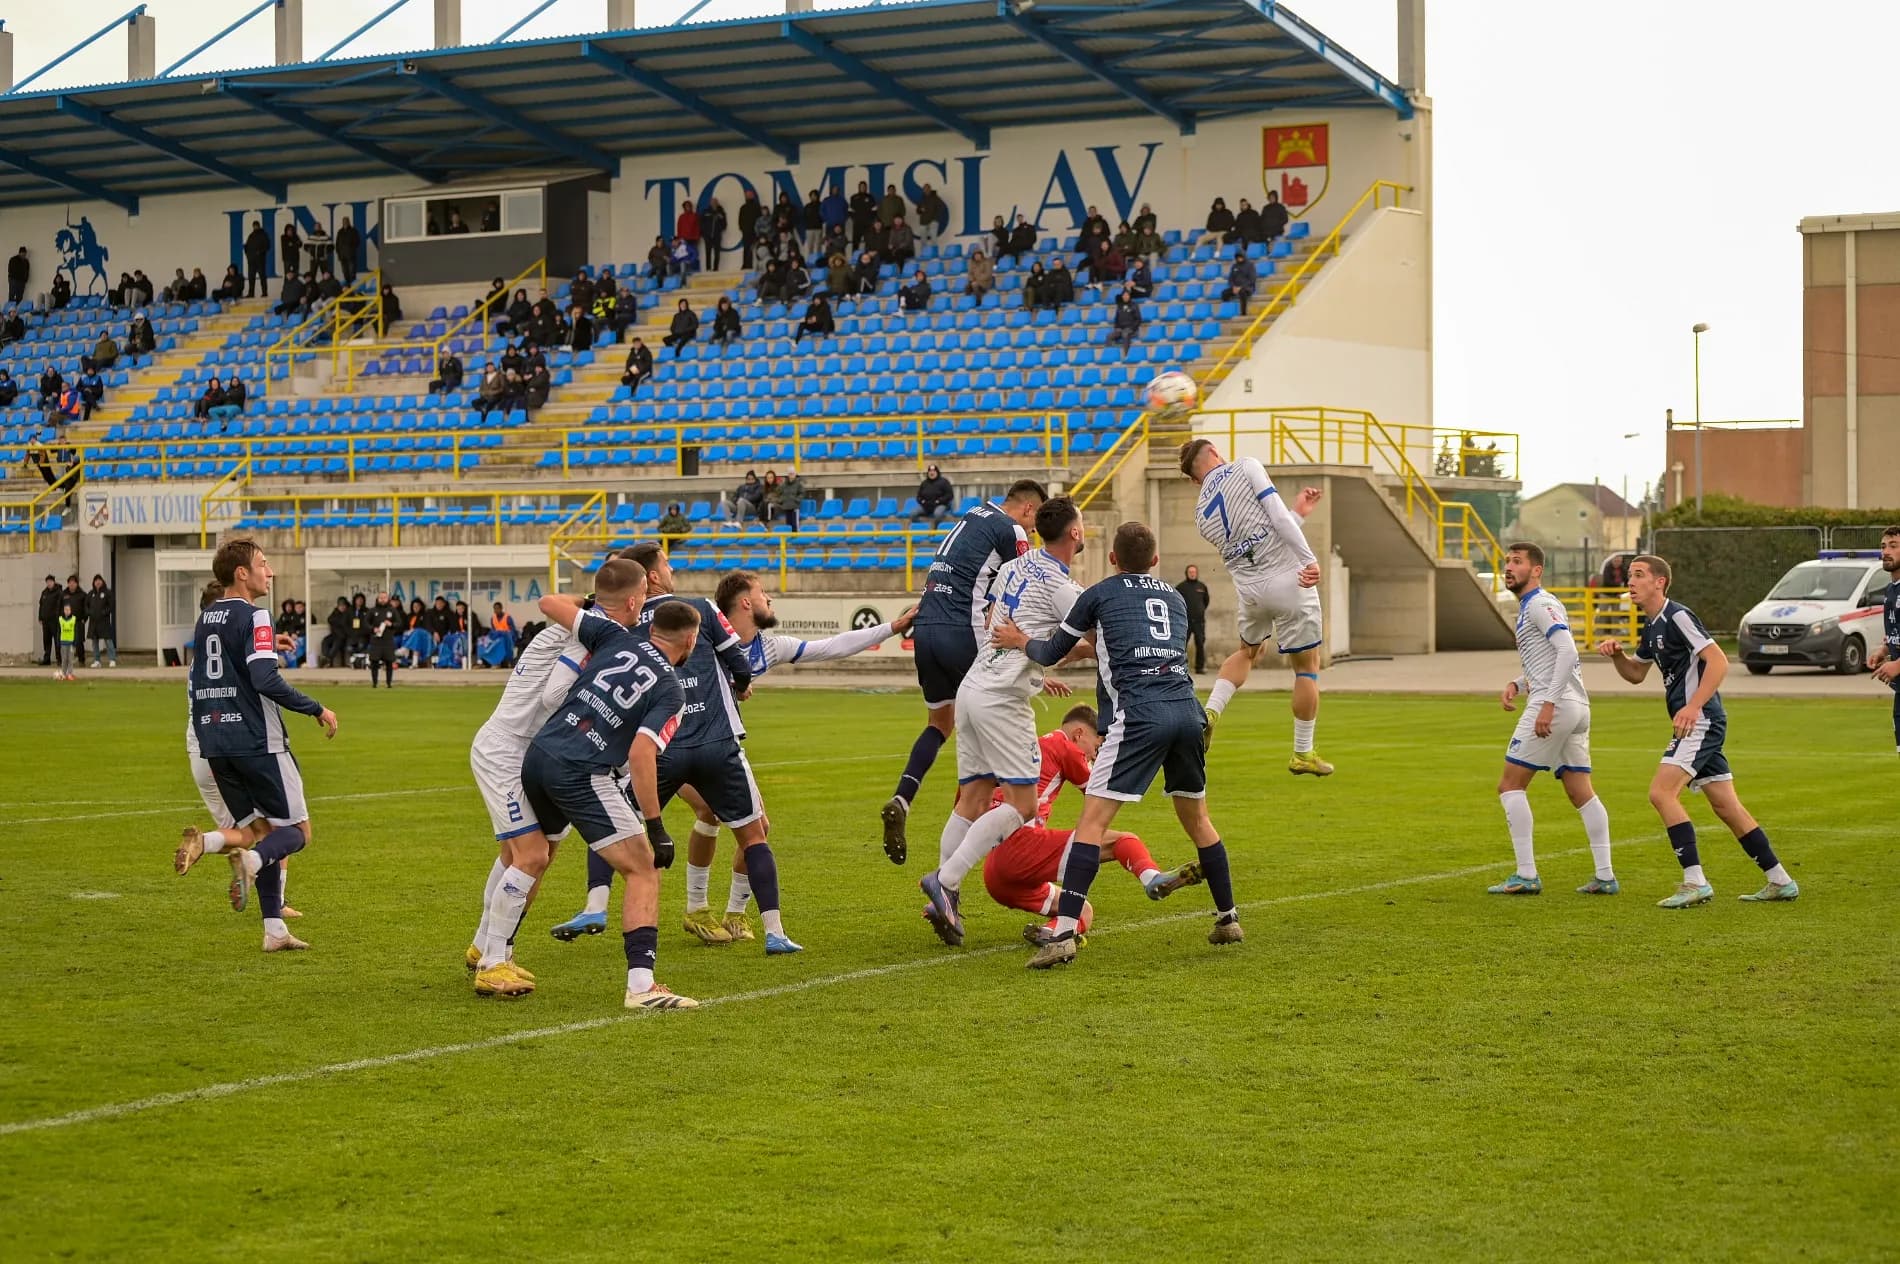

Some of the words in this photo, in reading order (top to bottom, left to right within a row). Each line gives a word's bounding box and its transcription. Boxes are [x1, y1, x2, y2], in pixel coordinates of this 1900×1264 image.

[645, 142, 1163, 252] TOMISLAV
[112, 496, 147, 524] HNK
[1203, 491, 1231, 543] 7
[1001, 570, 1029, 619] 4
[1145, 597, 1172, 641] 9
[206, 634, 224, 680] 8
[592, 650, 658, 710] 23
[220, 713, 242, 723] 2025
[586, 728, 608, 752] 2025
[507, 801, 524, 823] 2
